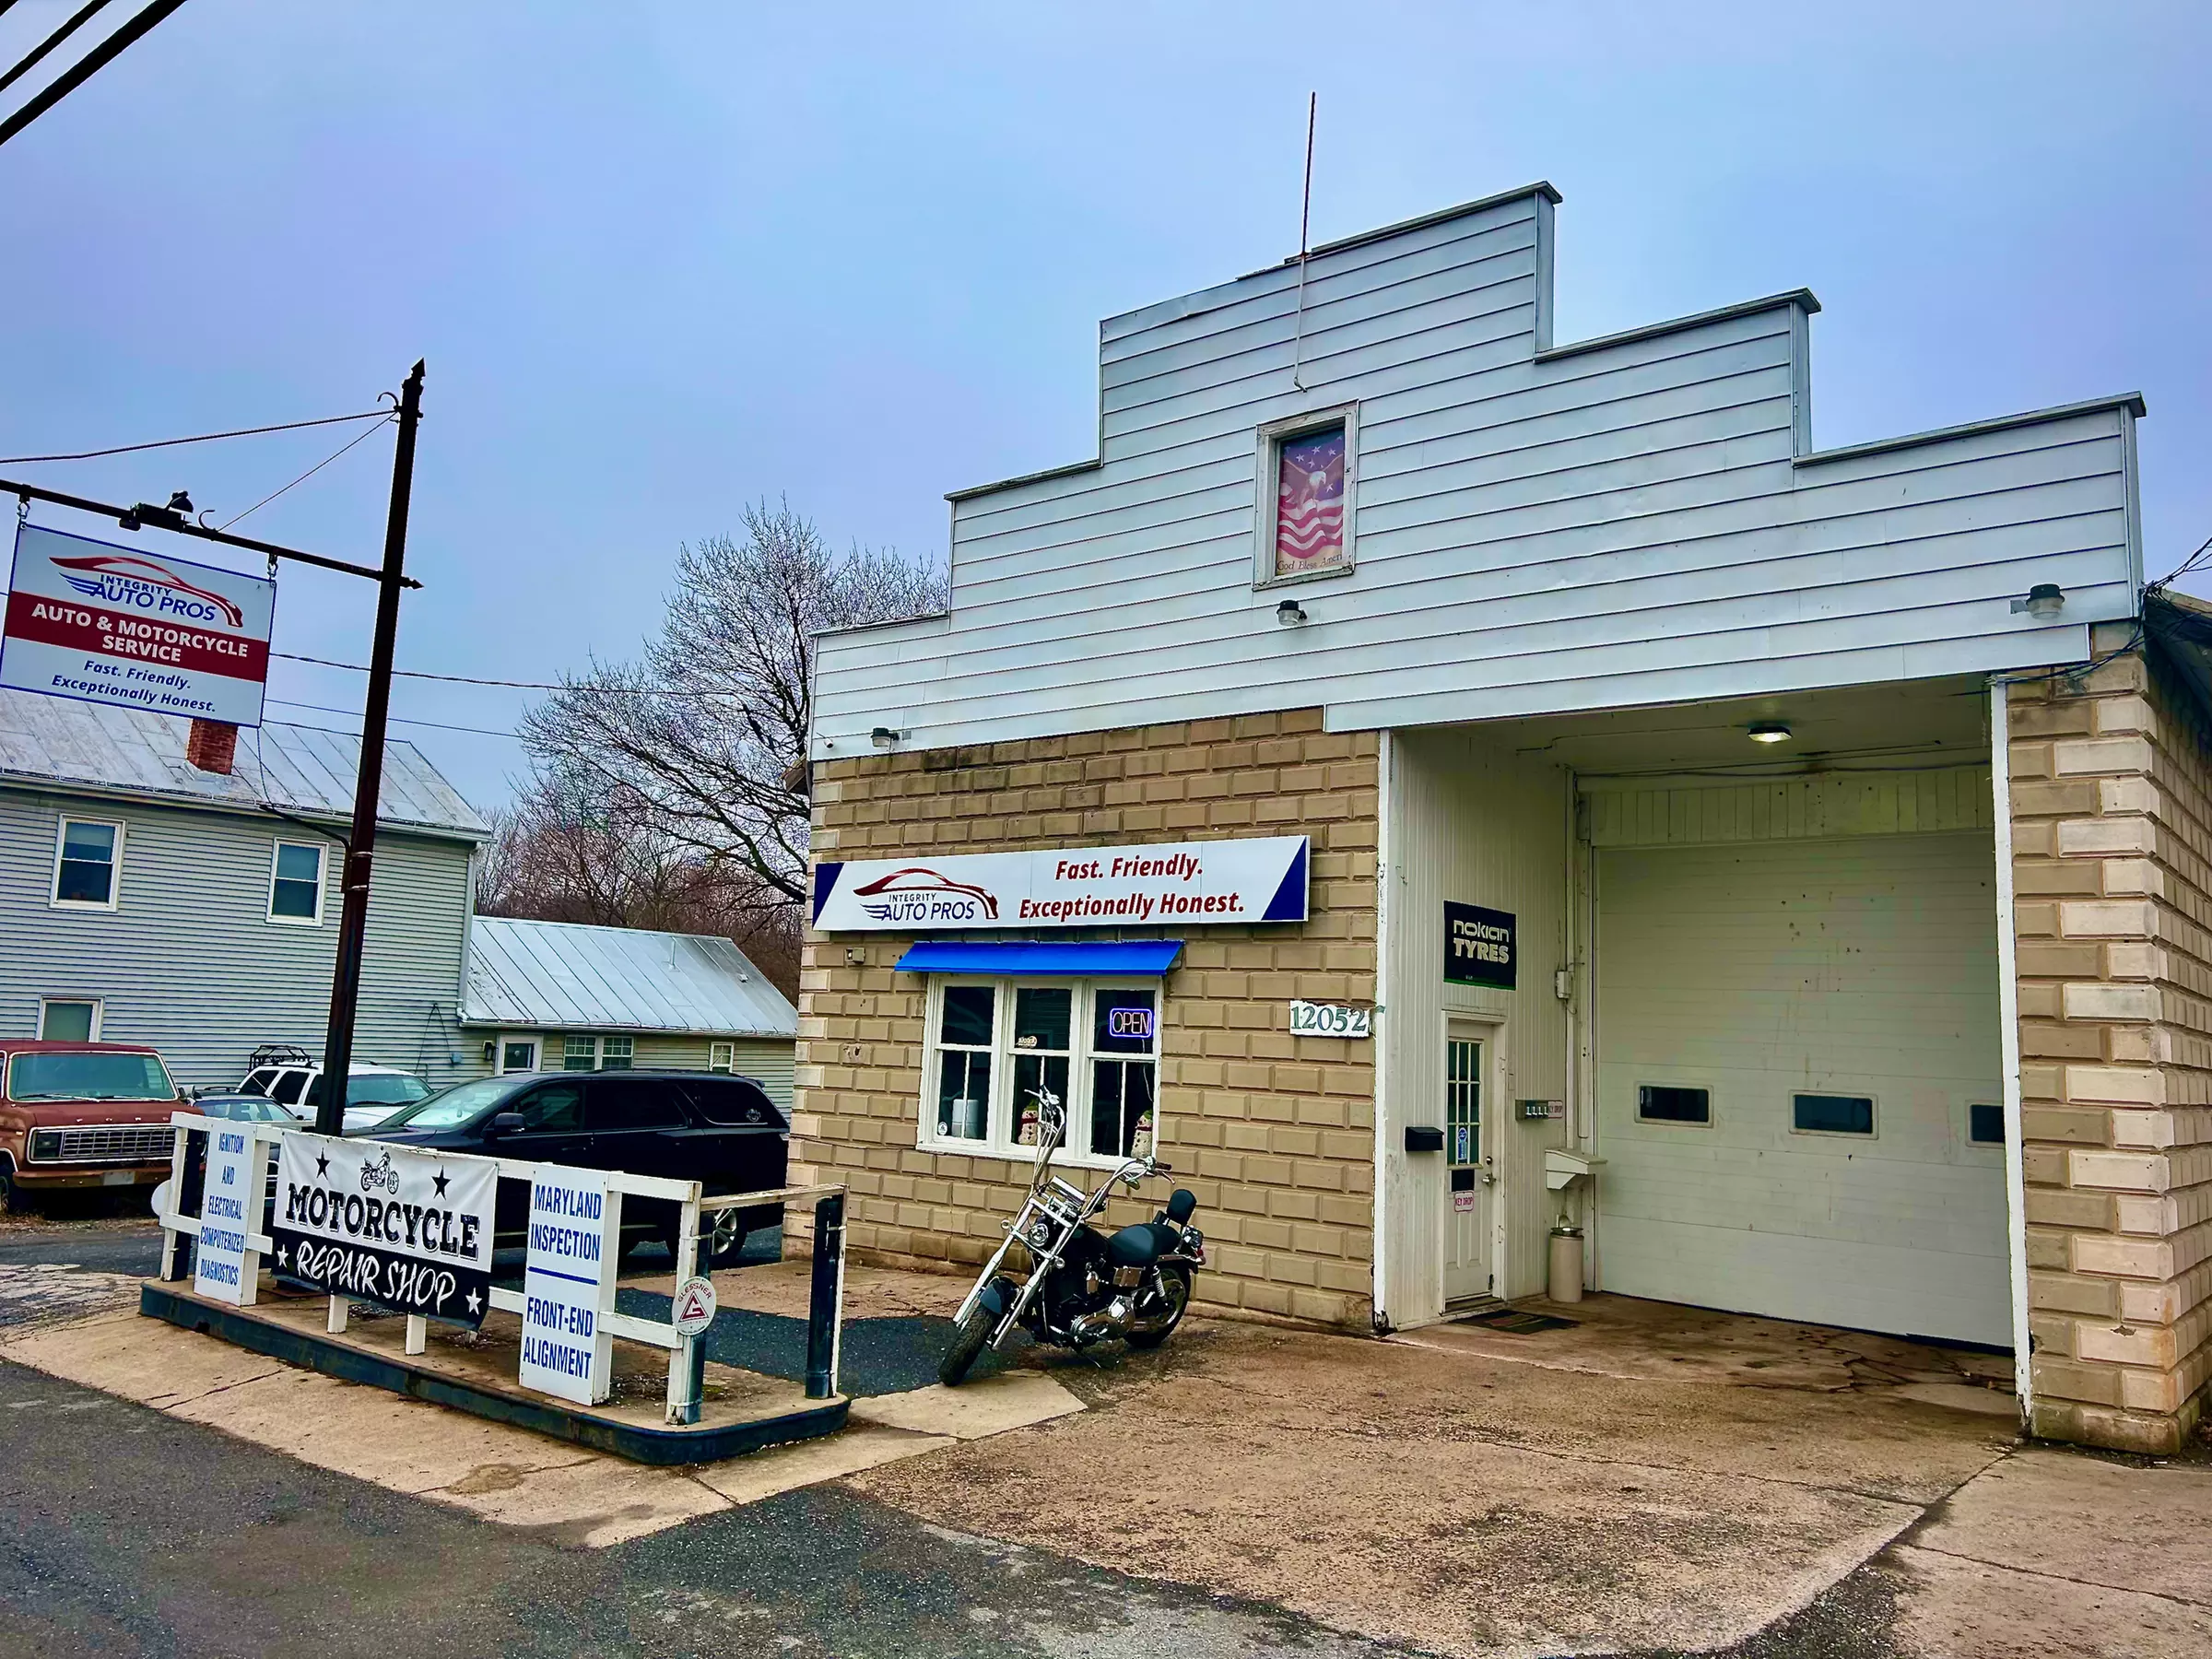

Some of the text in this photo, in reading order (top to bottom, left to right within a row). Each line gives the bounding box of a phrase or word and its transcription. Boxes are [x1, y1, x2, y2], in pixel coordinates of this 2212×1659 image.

[1277, 554, 1342, 571] God Bless Ameri
[100, 574, 172, 596] INTEGRITY
[90, 582, 217, 621] AUTO PROS
[31, 604, 249, 658] AUTO & MOTORCYCLE
[102, 635, 182, 662] SERVICE
[83, 660, 192, 689] Fast. Friendly.
[52, 675, 216, 712] Exceptionally Honest.
[1055, 853, 1203, 881] Fast. Friendly.
[888, 892, 936, 902] INTEGRITY
[1019, 892, 1244, 922] Exceptionally Honest.
[881, 901, 976, 921] AUTO PROS
[1453, 937, 1509, 964] TYRES
[1112, 1012, 1149, 1034] OPEN
[1290, 1006, 1367, 1032] 12052
[218, 1132, 245, 1155] IGNITION
[221, 1165, 235, 1185] AND
[207, 1195, 242, 1220] ELECTRICAL
[534, 1184, 602, 1220] MARYLAND
[285, 1182, 480, 1262] MOTORCYCLE
[200, 1226, 244, 1253] COMPUTERIZED
[530, 1223, 600, 1262] INSPECTION
[200, 1258, 239, 1286] DIAGNOSTICS
[297, 1241, 456, 1316] REPAIR SHOP
[677, 1282, 712, 1302] GLESSNER
[526, 1297, 594, 1337] FRONT-END
[523, 1336, 592, 1380] ALIGNMENT
